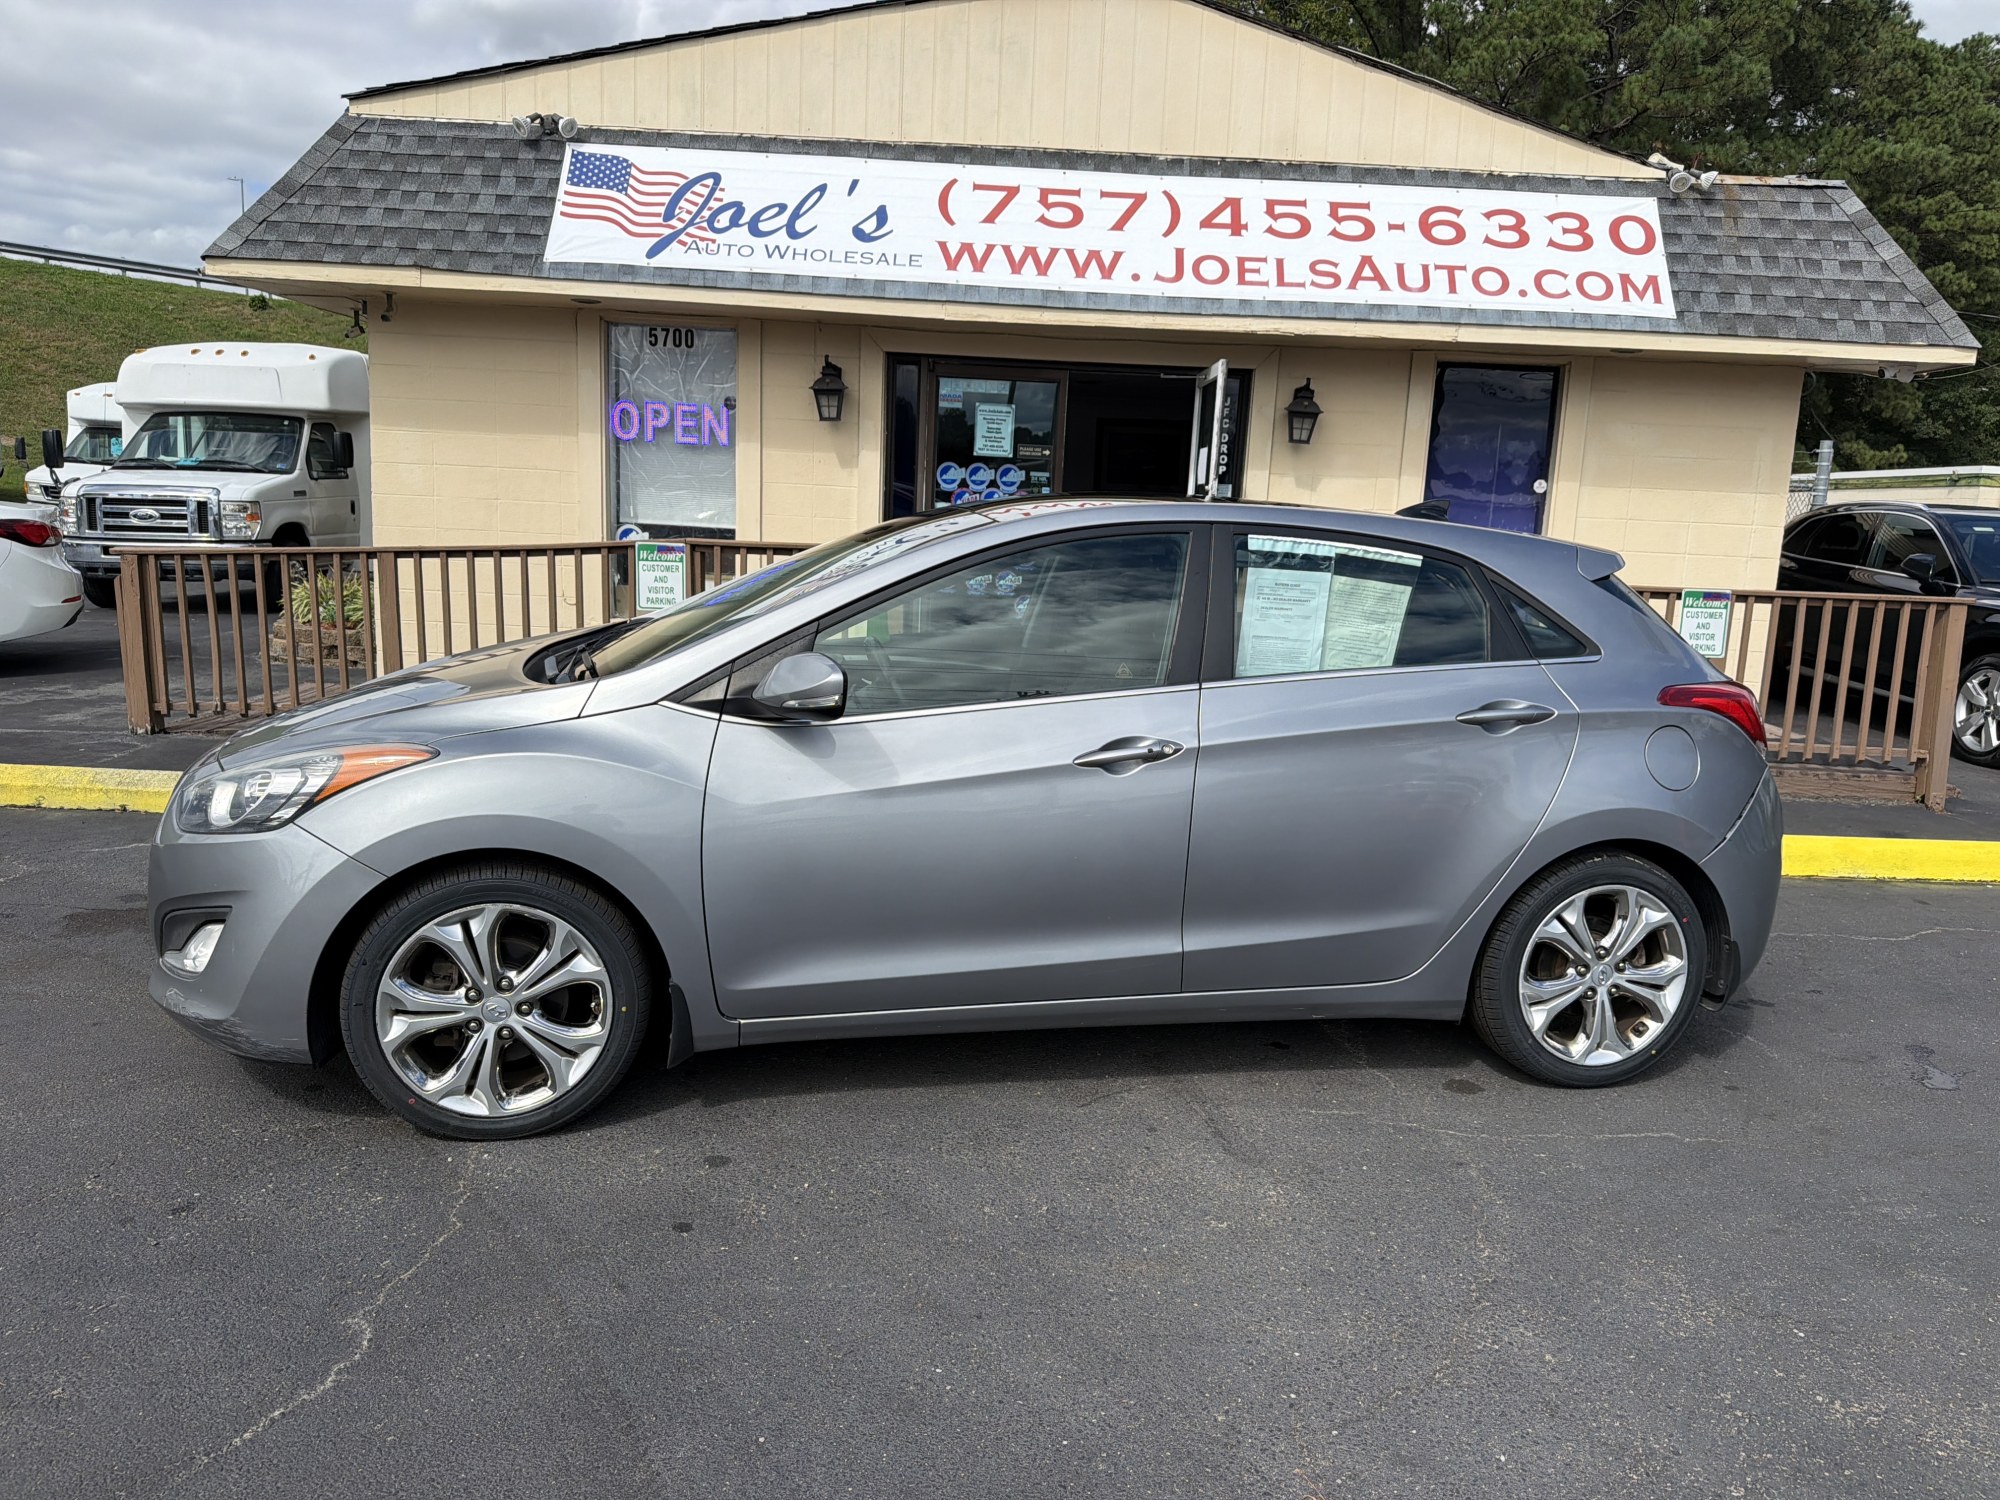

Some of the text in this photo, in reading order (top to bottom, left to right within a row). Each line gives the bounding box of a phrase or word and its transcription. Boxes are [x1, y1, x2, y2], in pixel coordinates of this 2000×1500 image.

[645, 170, 894, 261] Joel's
[937, 178, 1658, 257] (757)455-6330
[648, 327, 695, 349] 5700
[610, 399, 729, 447] OPEN
[1218, 433, 1229, 475] DROP
[640, 550, 682, 562] Welcome
[641, 563, 680, 573] CUSTOMER
[653, 575, 668, 584] AND
[647, 586, 675, 595] VISITOR
[1685, 597, 1726, 608] Welcome
[1685, 610, 1723, 620] CUSTOMER
[1691, 644, 1715, 652] RKING
